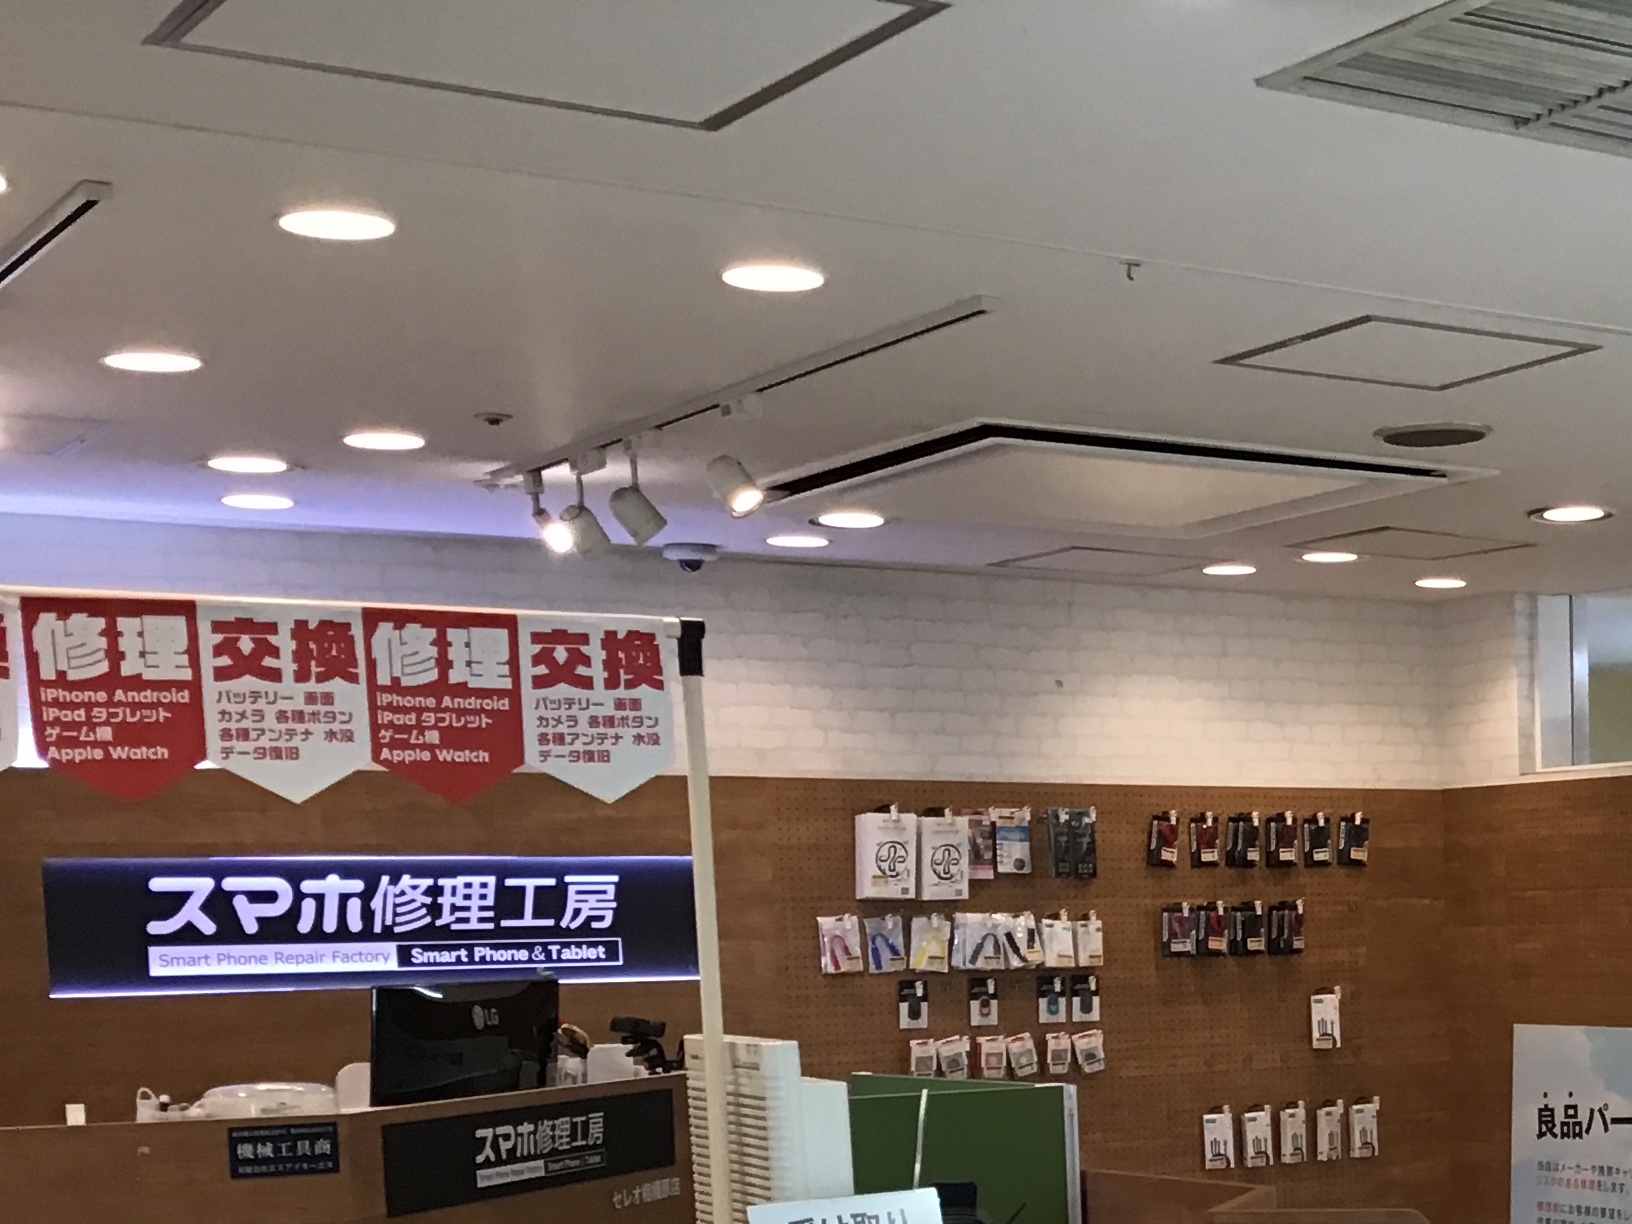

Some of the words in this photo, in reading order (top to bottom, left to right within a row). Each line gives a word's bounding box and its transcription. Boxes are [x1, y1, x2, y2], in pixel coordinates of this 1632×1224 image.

[32, 612, 193, 681] 修理
[211, 617, 360, 684] 交換
[371, 621, 513, 689] 修理
[530, 629, 664, 691] 交換
[40, 688, 108, 703] iPhone
[113, 688, 189, 704] Android
[216, 690, 293, 706] バッテリー
[304, 691, 334, 706] 画面
[376, 692, 436, 708] iPhone
[440, 695, 509, 710] Android
[534, 697, 605, 712] バッテリー
[42, 707, 85, 722] iPad
[92, 707, 171, 723] タブレット
[218, 709, 265, 724] カメラ
[275, 709, 352, 724] 各種ボタン
[377, 712, 416, 726] iPad
[421, 713, 493, 728] タブレット
[536, 715, 578, 728] カメラ
[587, 715, 659, 729] 各種ボタン
[45, 726, 113, 742] ゲーム機
[219, 728, 314, 743] 各種アンテナ
[323, 729, 354, 743] 水没
[379, 730, 440, 745] ゲーム機
[537, 732, 624, 746] 各種アンテナ
[632, 732, 661, 746] 水没
[48, 746, 105, 763] Apple
[109, 746, 168, 760] Watch
[220, 746, 300, 761] データ復旧
[379, 748, 430, 763] Apple
[435, 749, 489, 763] Watch
[538, 749, 611, 763] データ復旧
[146, 873, 620, 936] スマホ修理工房
[158, 952, 212, 968] Smart
[216, 951, 269, 968] Phone
[274, 950, 327, 968] Repair
[332, 948, 391, 967] Factory
[411, 946, 468, 964] Smart
[473, 945, 528, 962] Phone
[548, 943, 606, 960] Tablet
[484, 1008, 499, 1025] LG
[475, 1112, 604, 1164] スマホ修理工房
